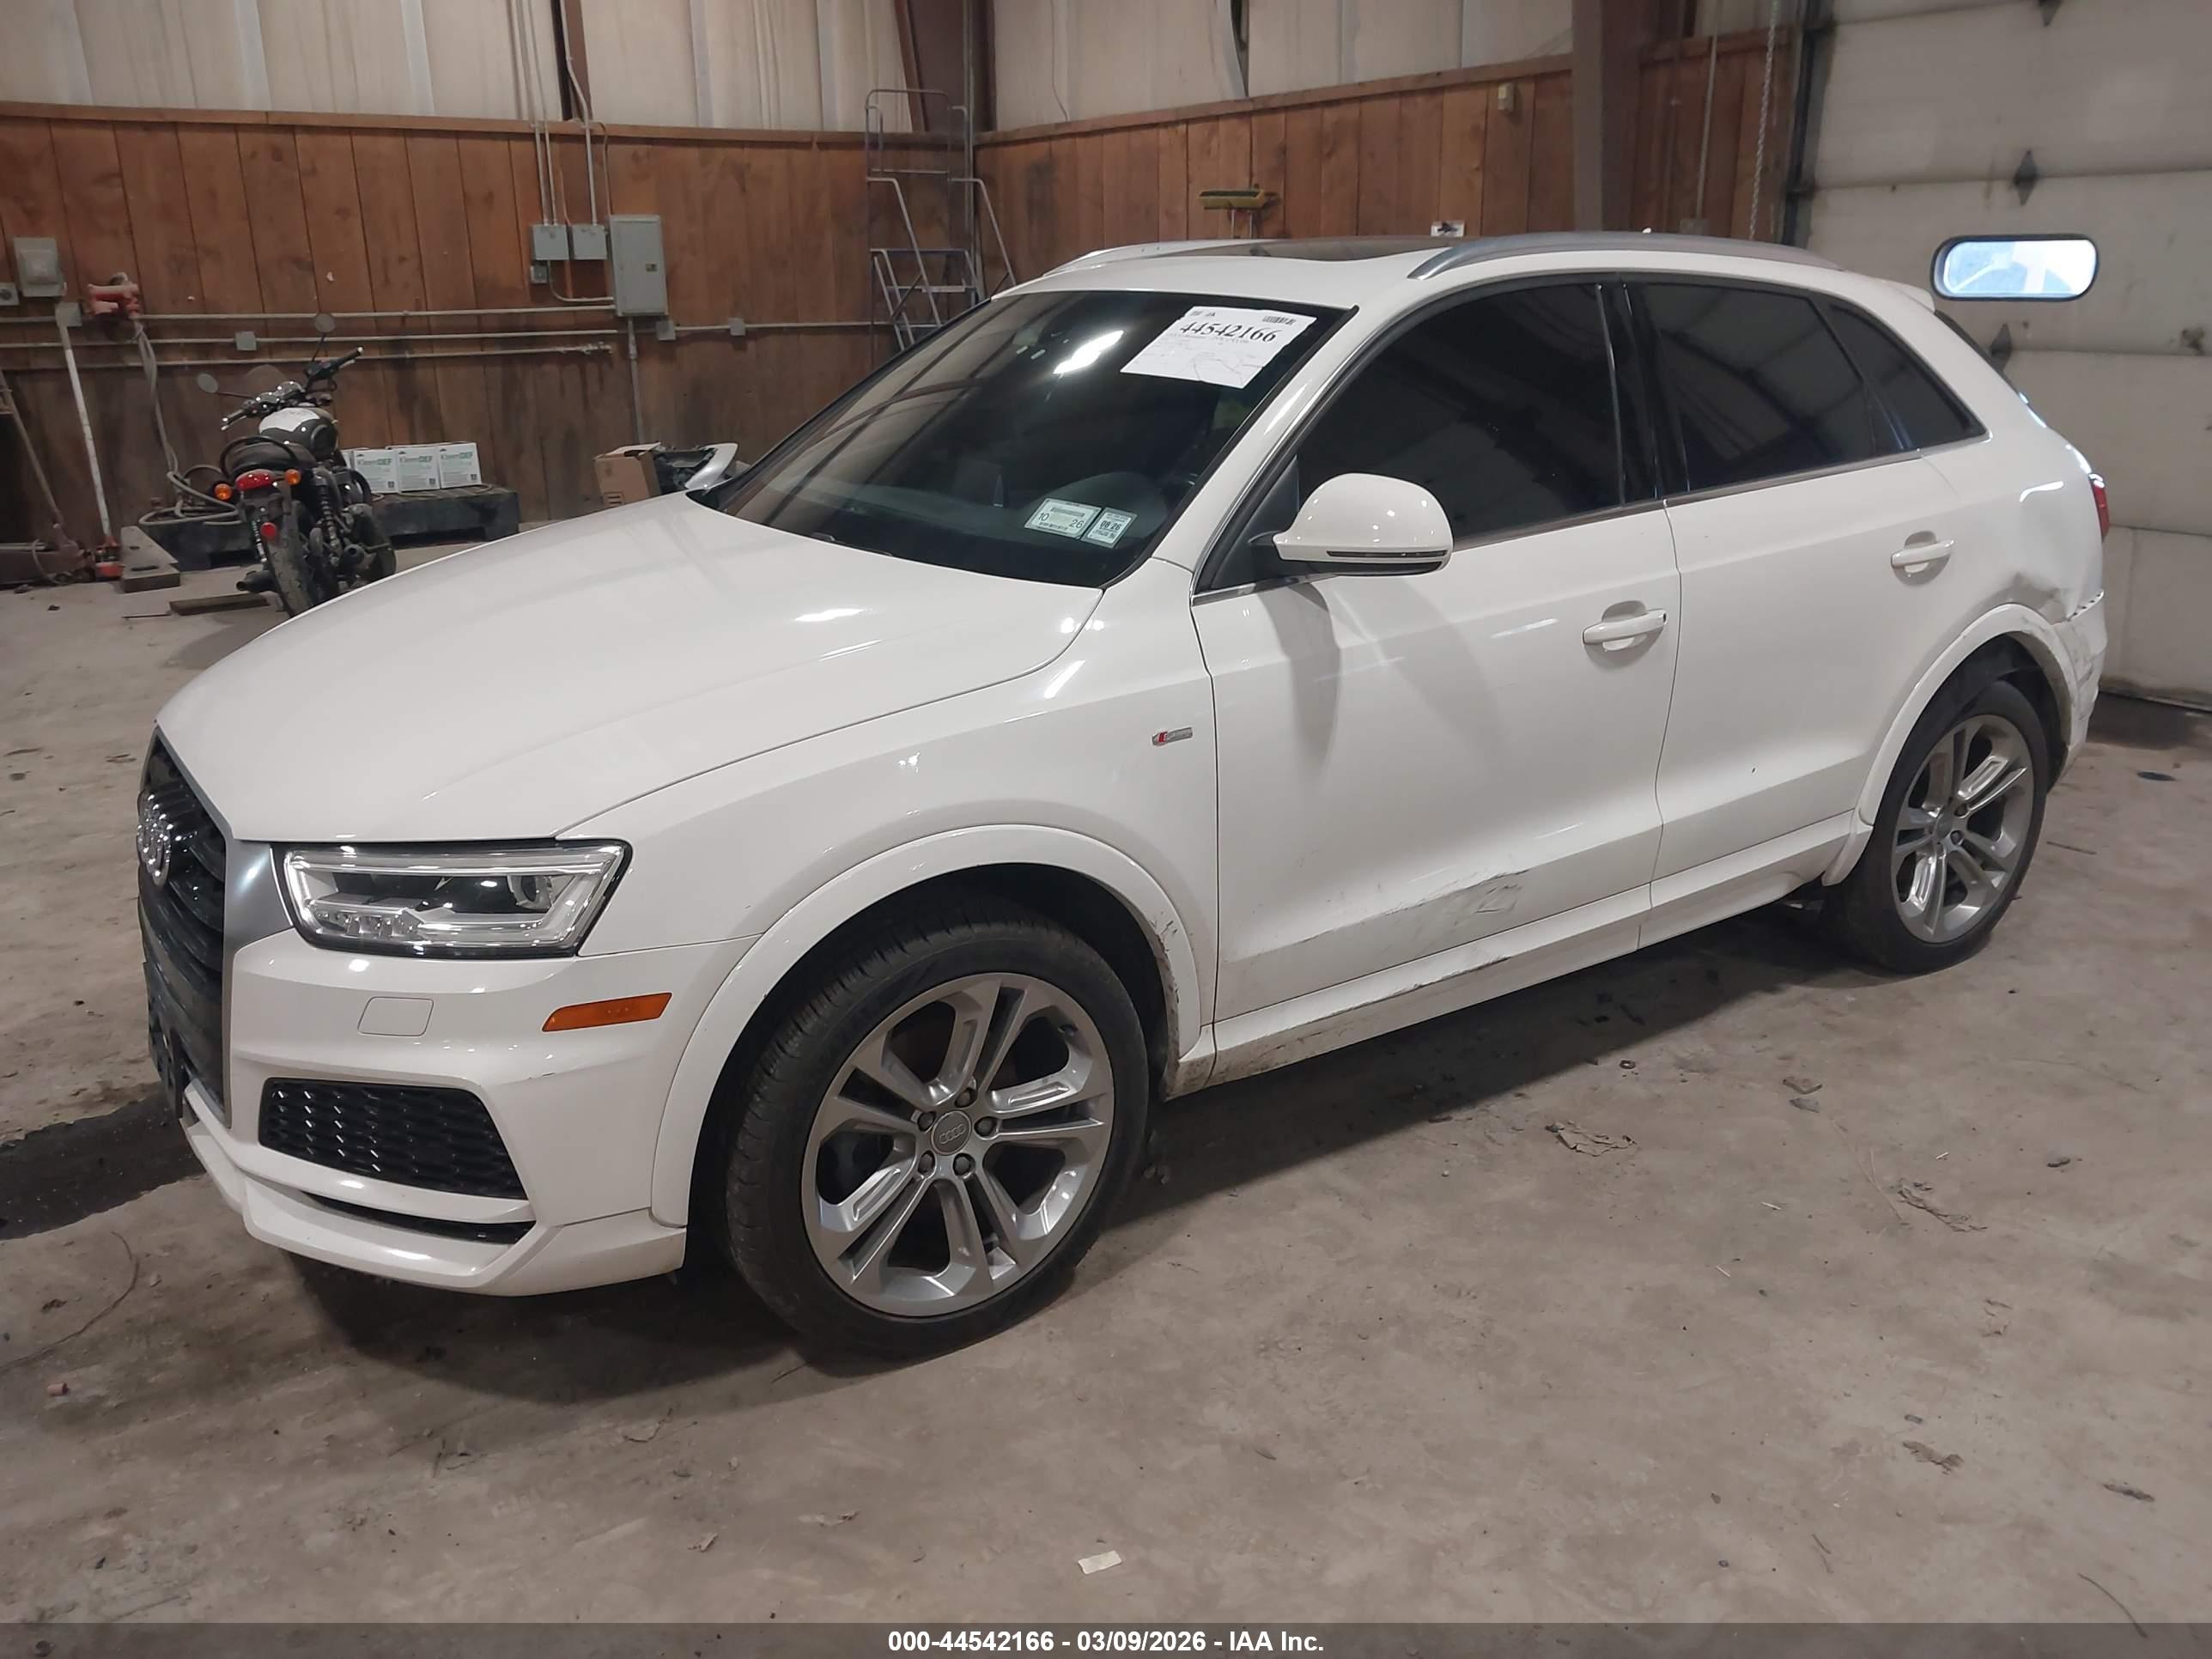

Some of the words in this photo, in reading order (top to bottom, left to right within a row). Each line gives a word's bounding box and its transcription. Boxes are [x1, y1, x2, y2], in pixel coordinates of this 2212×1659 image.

[1180, 321, 1284, 342] 44542166
[1038, 513, 1049, 521] 10
[1068, 519, 1085, 529] 26
